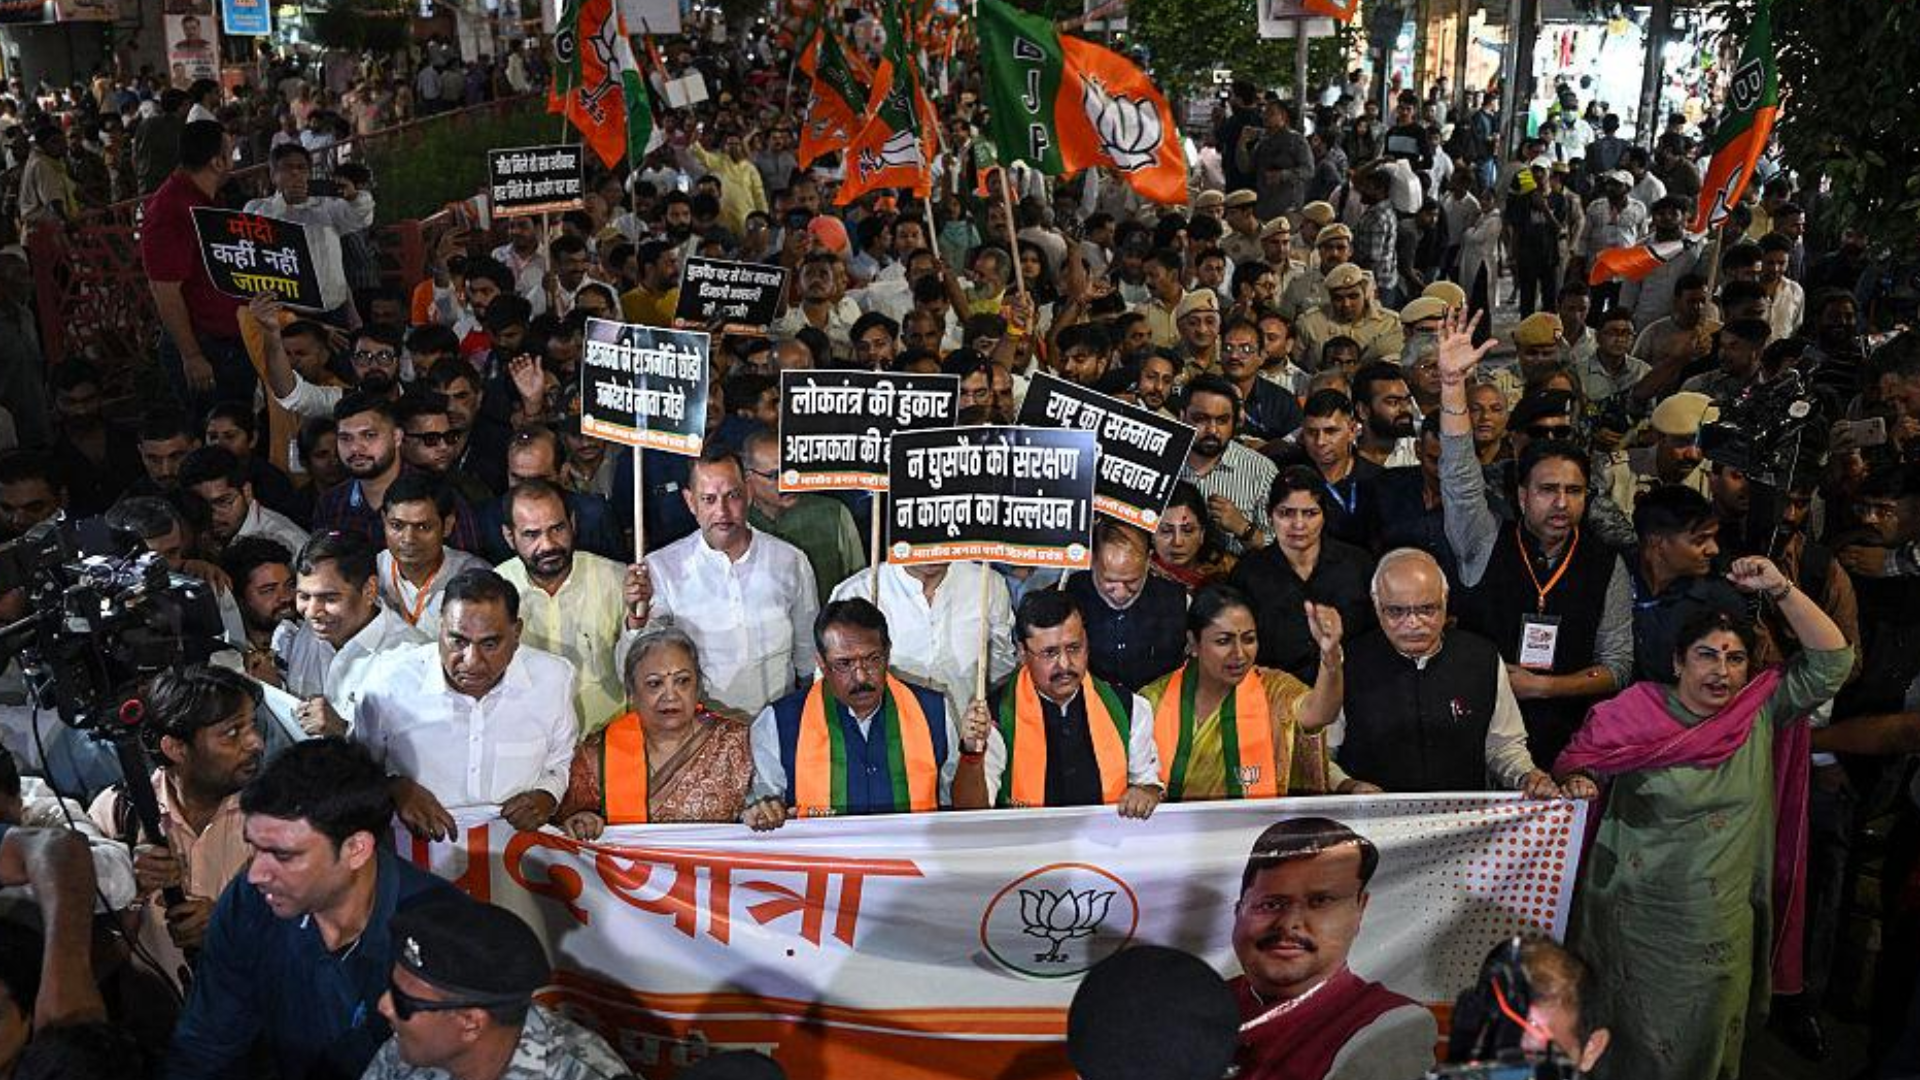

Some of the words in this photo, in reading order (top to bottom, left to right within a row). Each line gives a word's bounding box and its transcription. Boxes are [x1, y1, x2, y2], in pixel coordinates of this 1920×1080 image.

[226, 212, 275, 243] मोदी
[210, 239, 256, 269] कहीं
[262, 247, 299, 276] नहीं
[230, 271, 299, 298] जाएगा
[632, 342, 677, 378] राजनीति
[790, 378, 866, 415] लोकतंत्र
[867, 380, 896, 417] की
[896, 382, 952, 425] हुंकार
[1046, 390, 1081, 429] राष्ट्र
[1079, 401, 1106, 430] का
[1104, 411, 1173, 456] सम्मान
[785, 435, 857, 463] अराजकता
[858, 427, 882, 464] की
[907, 446, 925, 480] न
[926, 435, 984, 490] घुसपैठ
[984, 435, 1010, 476] को
[1013, 438, 1080, 480] संरक्षण
[1101, 454, 1160, 495] पहचान
[896, 497, 915, 529] न
[916, 493, 973, 537] कानून
[974, 492, 1000, 526] का
[1003, 489, 1074, 530] उल्लंघन
